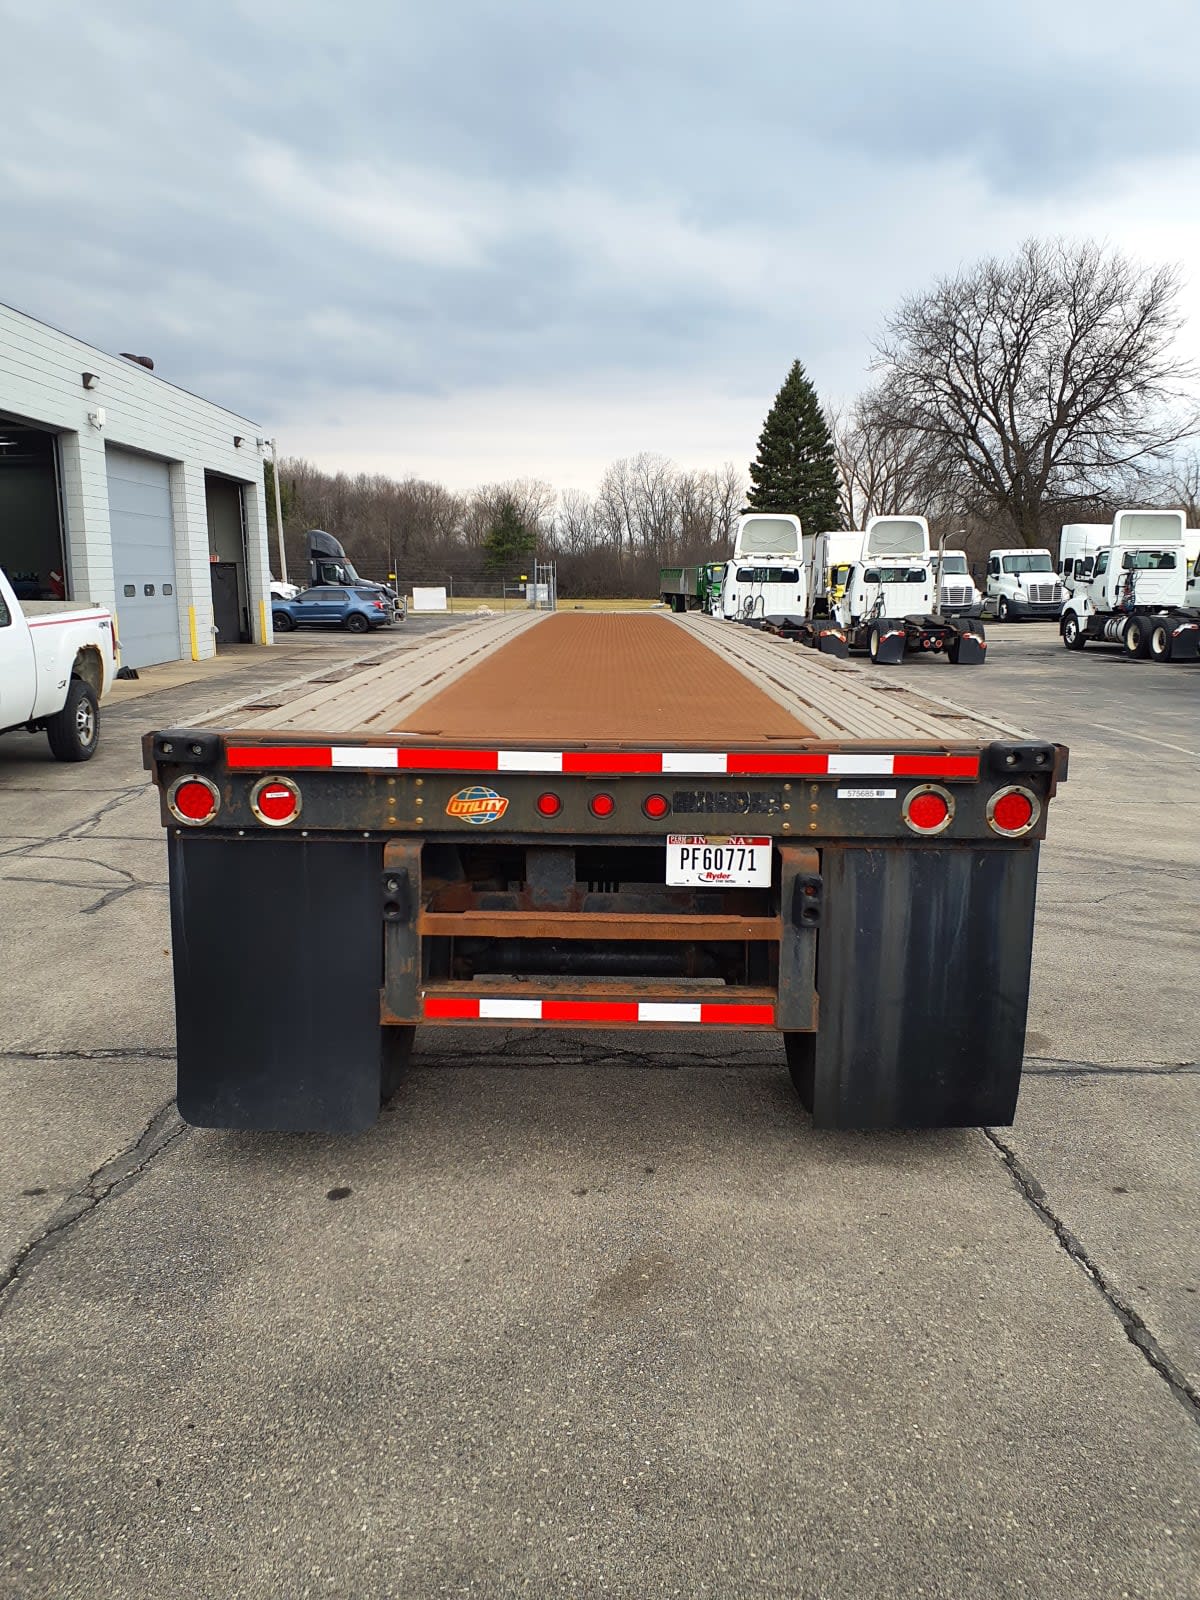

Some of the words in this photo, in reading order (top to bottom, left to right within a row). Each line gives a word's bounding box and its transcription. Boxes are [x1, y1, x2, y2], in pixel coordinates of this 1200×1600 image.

[450, 800, 505, 812] UTILITY
[693, 836, 746, 845] INNA
[680, 847, 757, 871] PF60771
[705, 871, 731, 880] Ryder
